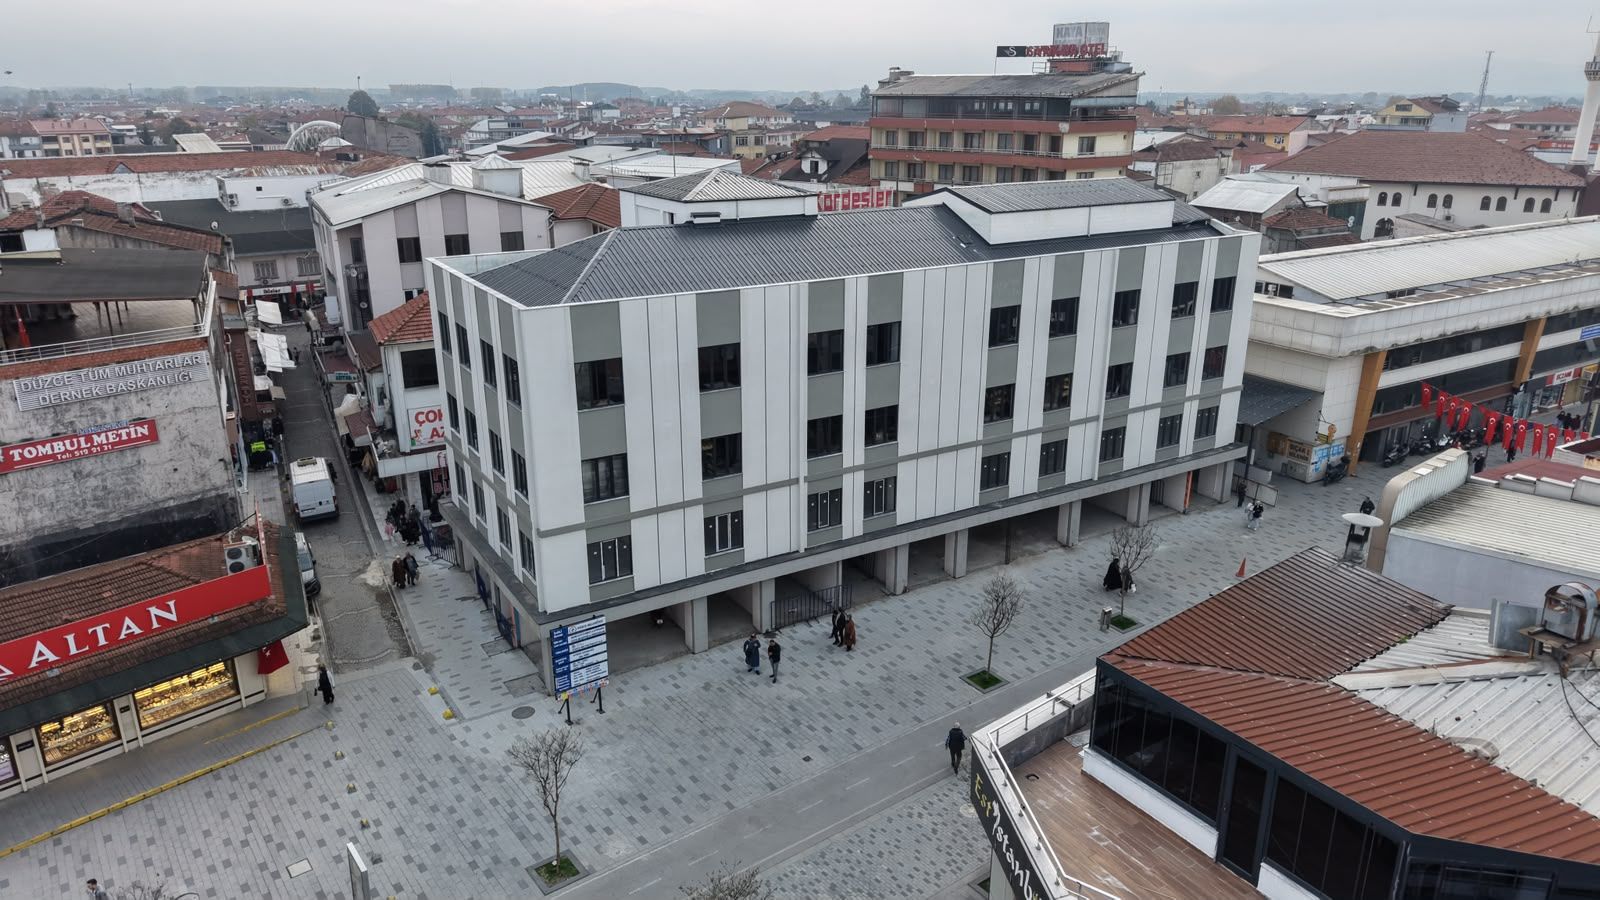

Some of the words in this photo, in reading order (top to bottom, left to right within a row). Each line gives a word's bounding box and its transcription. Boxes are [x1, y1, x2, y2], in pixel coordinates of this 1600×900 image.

[21, 374, 73, 392] DÜZCE
[80, 367, 110, 383] TÜM
[39, 386, 102, 405] DERNEK
[10, 437, 91, 461] TOMBUL
[93, 424, 149, 446] METİN
[28, 600, 178, 669] ALTAN
